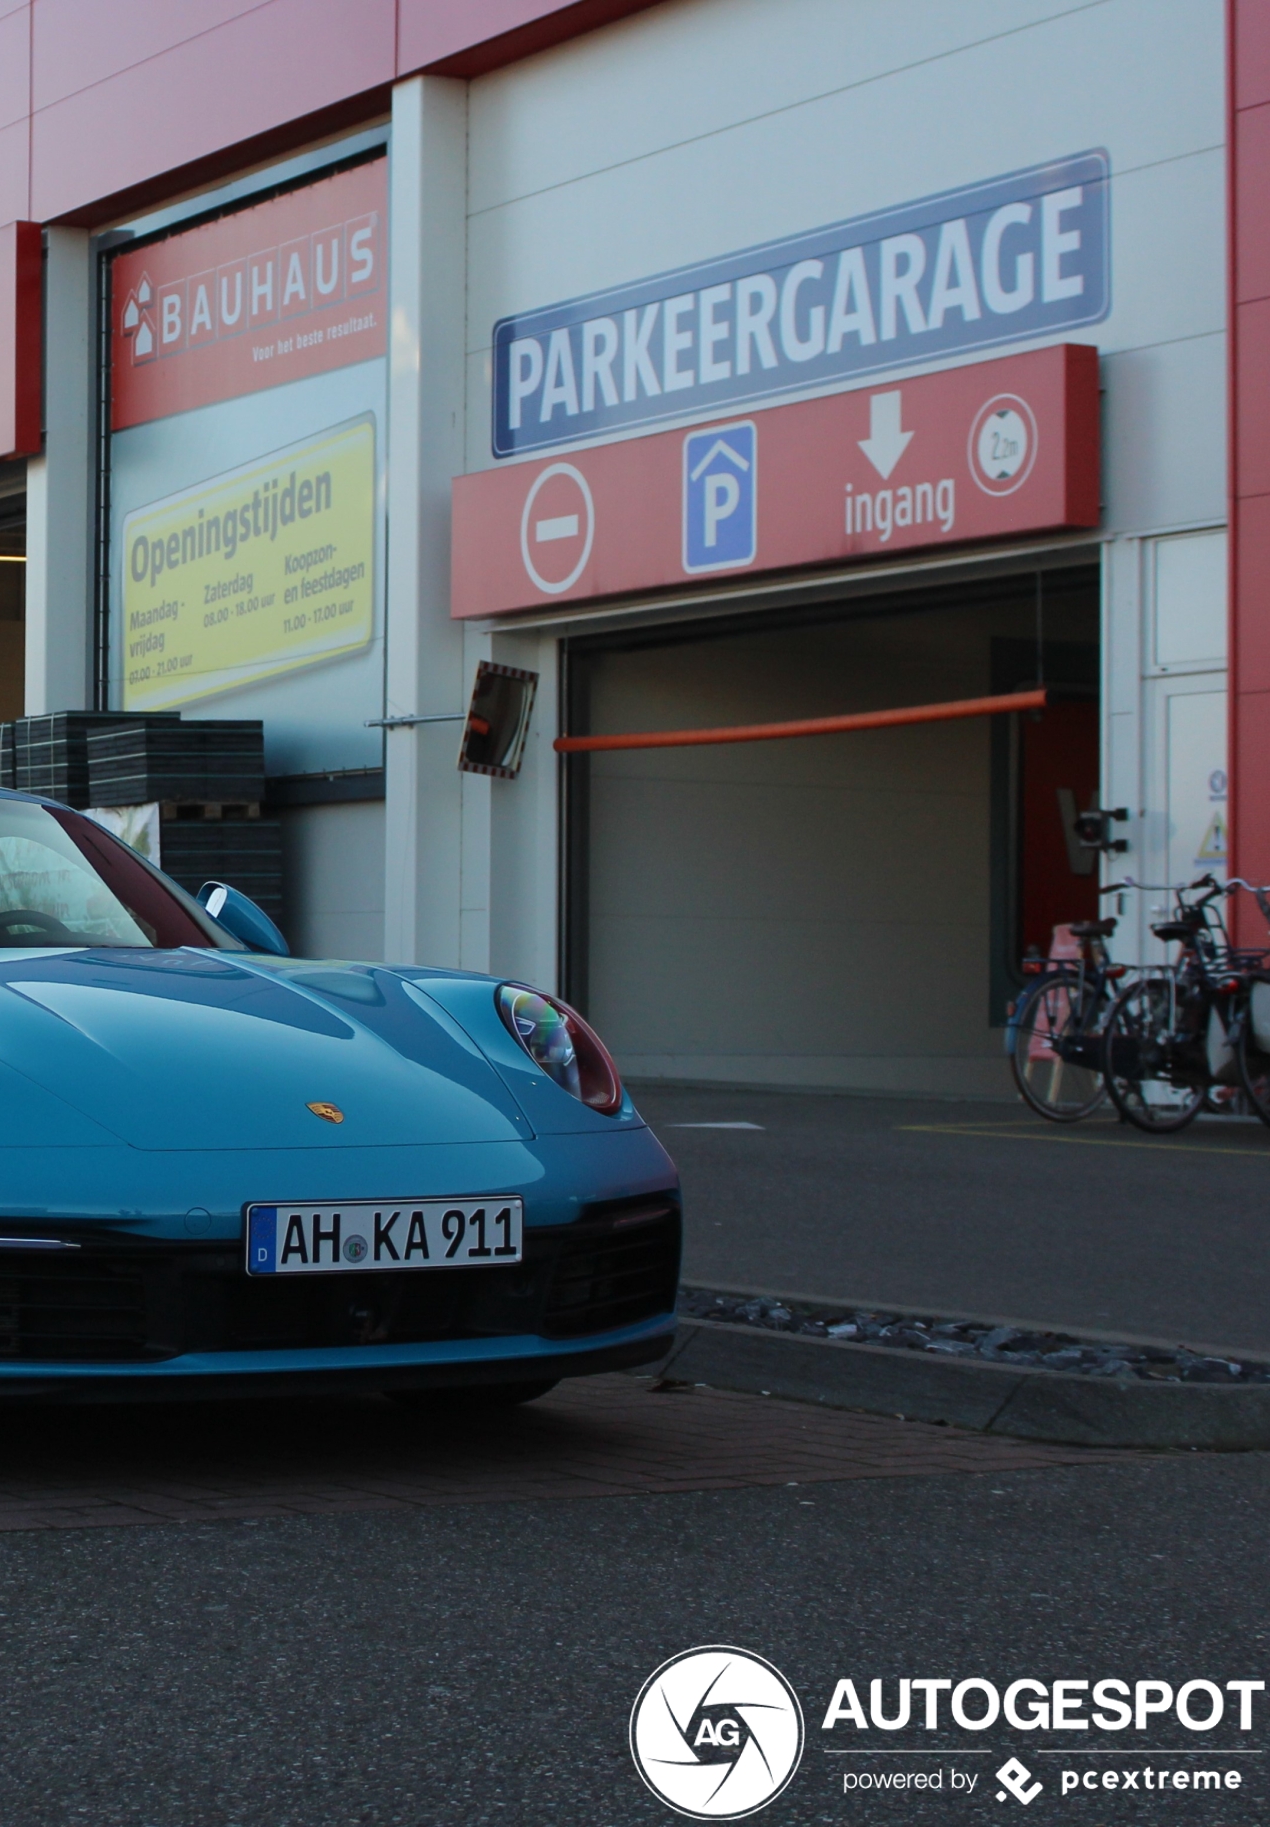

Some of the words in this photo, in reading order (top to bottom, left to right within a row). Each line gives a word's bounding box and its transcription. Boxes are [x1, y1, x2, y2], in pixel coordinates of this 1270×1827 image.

[162, 226, 374, 345] BAUHAUS
[508, 186, 1084, 430] PARKEERGARAGE
[252, 345, 274, 363] Voor
[277, 338, 293, 355] het
[296, 330, 324, 351] beste
[327, 312, 377, 339] resultaat.
[130, 470, 332, 588] Openingstijden
[703, 473, 739, 548] P
[844, 475, 956, 544] ingang
[284, 542, 337, 576] Koopzon-
[203, 571, 253, 604] Zaterdag
[284, 586, 298, 605] en
[301, 562, 365, 600] feestdagen
[129, 601, 179, 631] Maandag
[203, 608, 229, 628] 08.00
[235, 597, 259, 618] 18.00
[260, 592, 276, 608] uur
[283, 615, 307, 634] 11.00
[313, 604, 337, 625] 17.00
[338, 599, 355, 616] uur
[129, 630, 166, 659] vrijdag
[157, 657, 179, 677] 21.00
[179, 653, 193, 668] uur
[257, 1247, 268, 1262] D
[280, 1213, 341, 1264] AH
[373, 1210, 430, 1262] KA
[440, 1206, 518, 1258] 911
